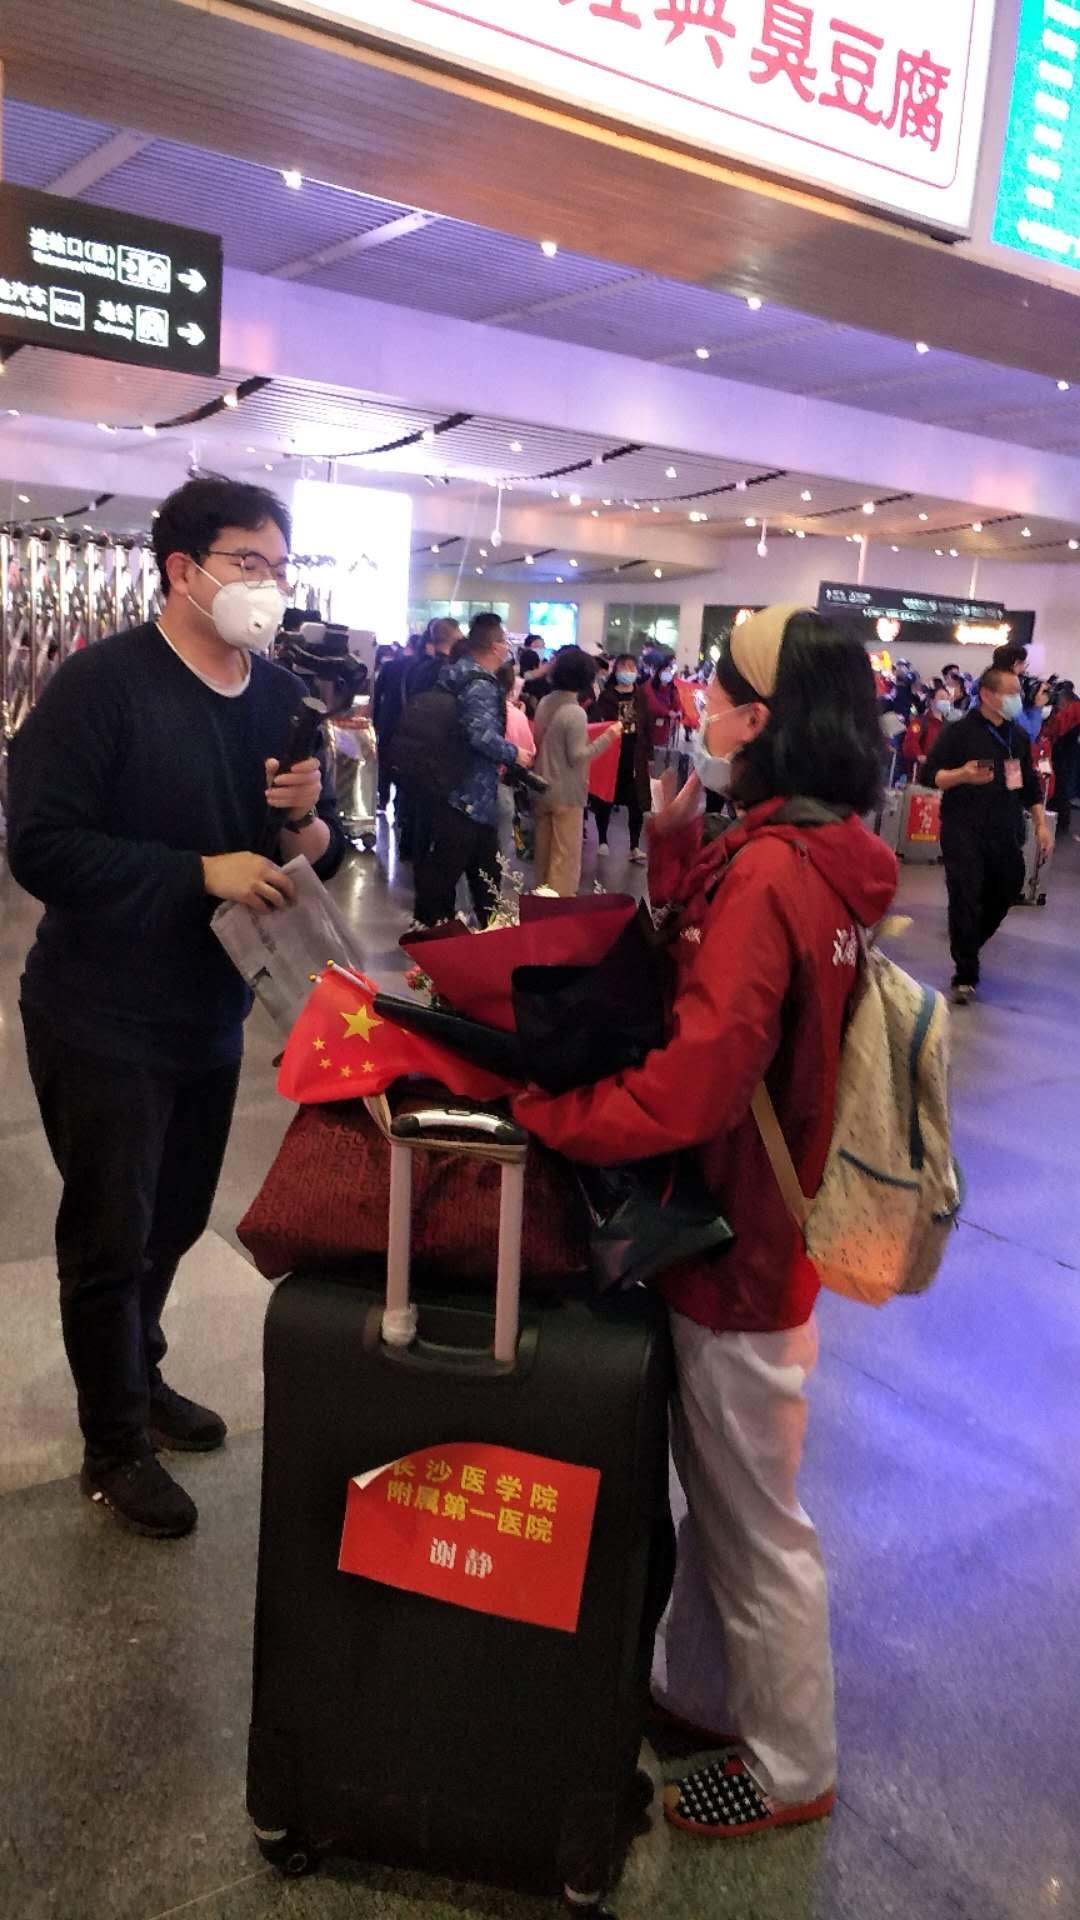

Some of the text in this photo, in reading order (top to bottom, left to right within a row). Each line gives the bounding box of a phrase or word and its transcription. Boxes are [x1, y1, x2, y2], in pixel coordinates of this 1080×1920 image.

[558, 0, 951, 152] 典臭豆腐
[386, 1479, 553, 1544] 附属第一医院
[390, 1459, 559, 1513] 长沙医学院
[430, 1536, 494, 1579] 谢静
